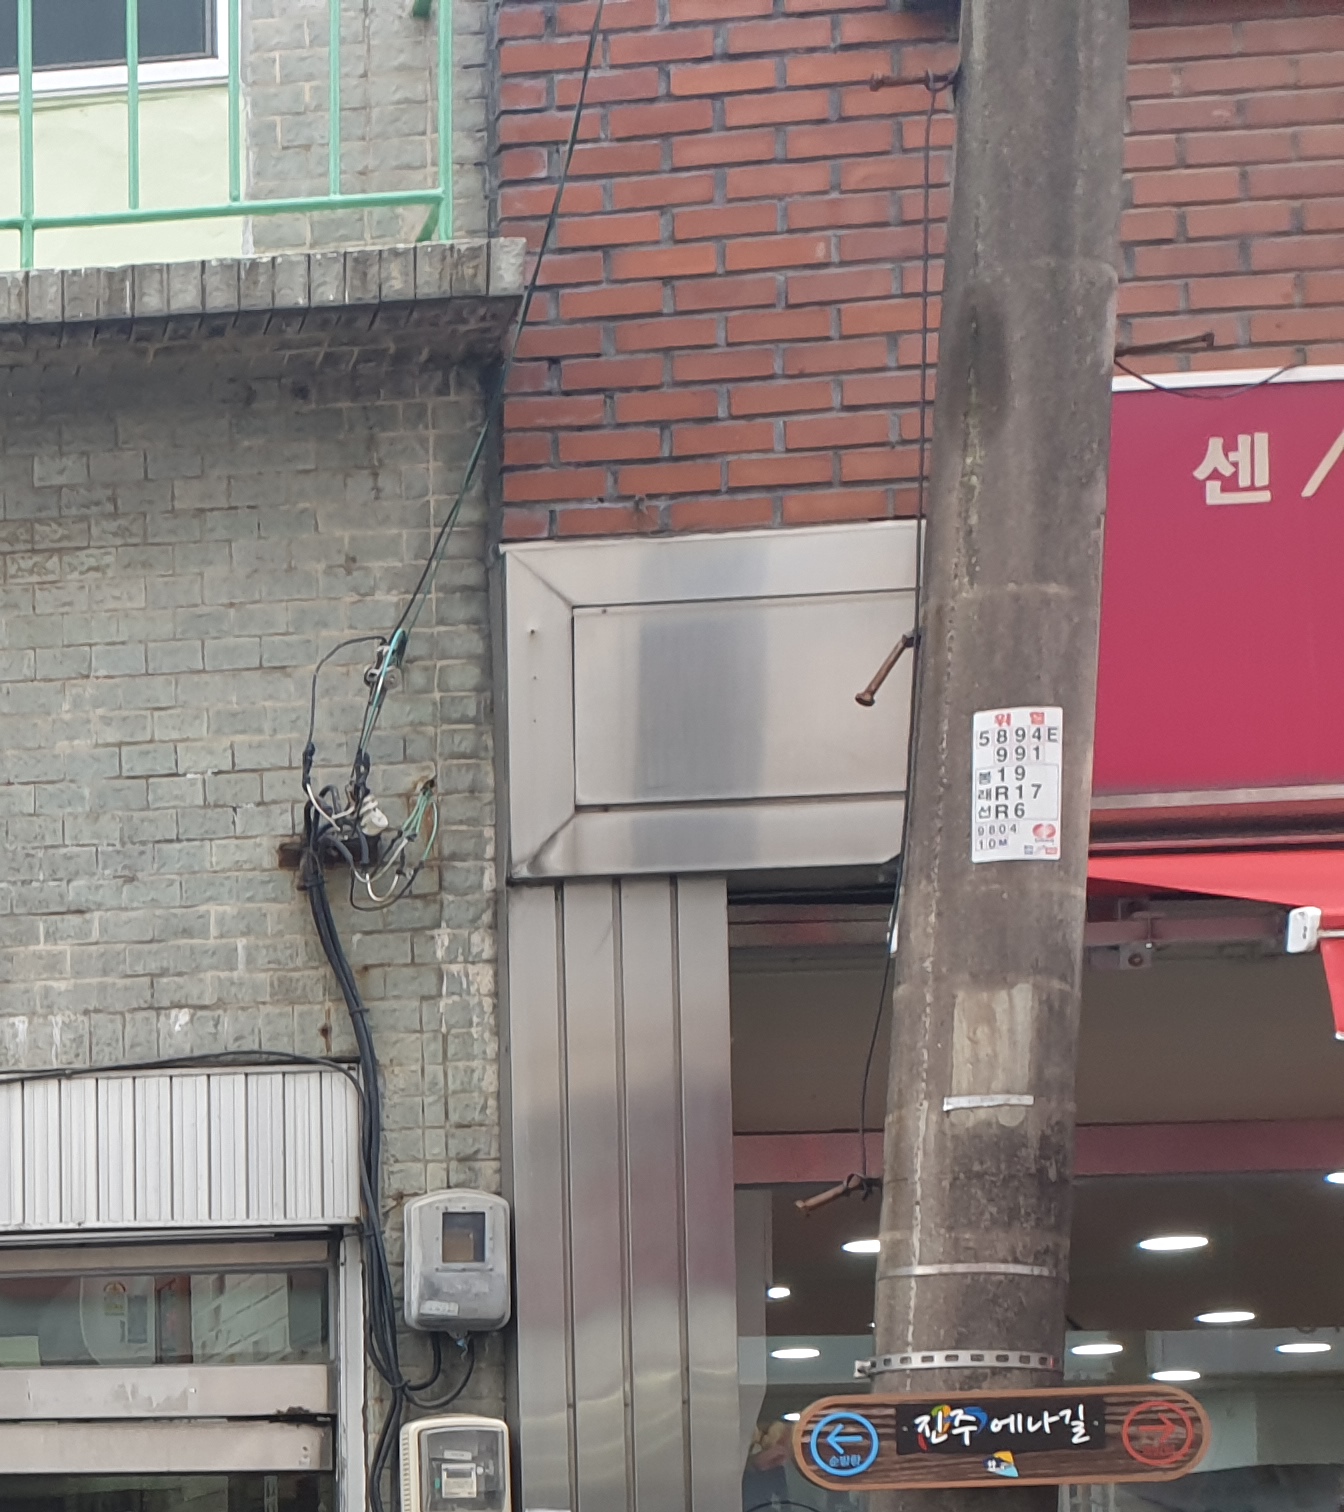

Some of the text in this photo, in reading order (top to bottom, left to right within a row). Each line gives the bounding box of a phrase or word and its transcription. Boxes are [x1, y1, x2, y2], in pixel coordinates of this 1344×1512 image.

[1192, 431, 1273, 506] 센
[912, 1403, 1092, 1449] 진주 에나길
